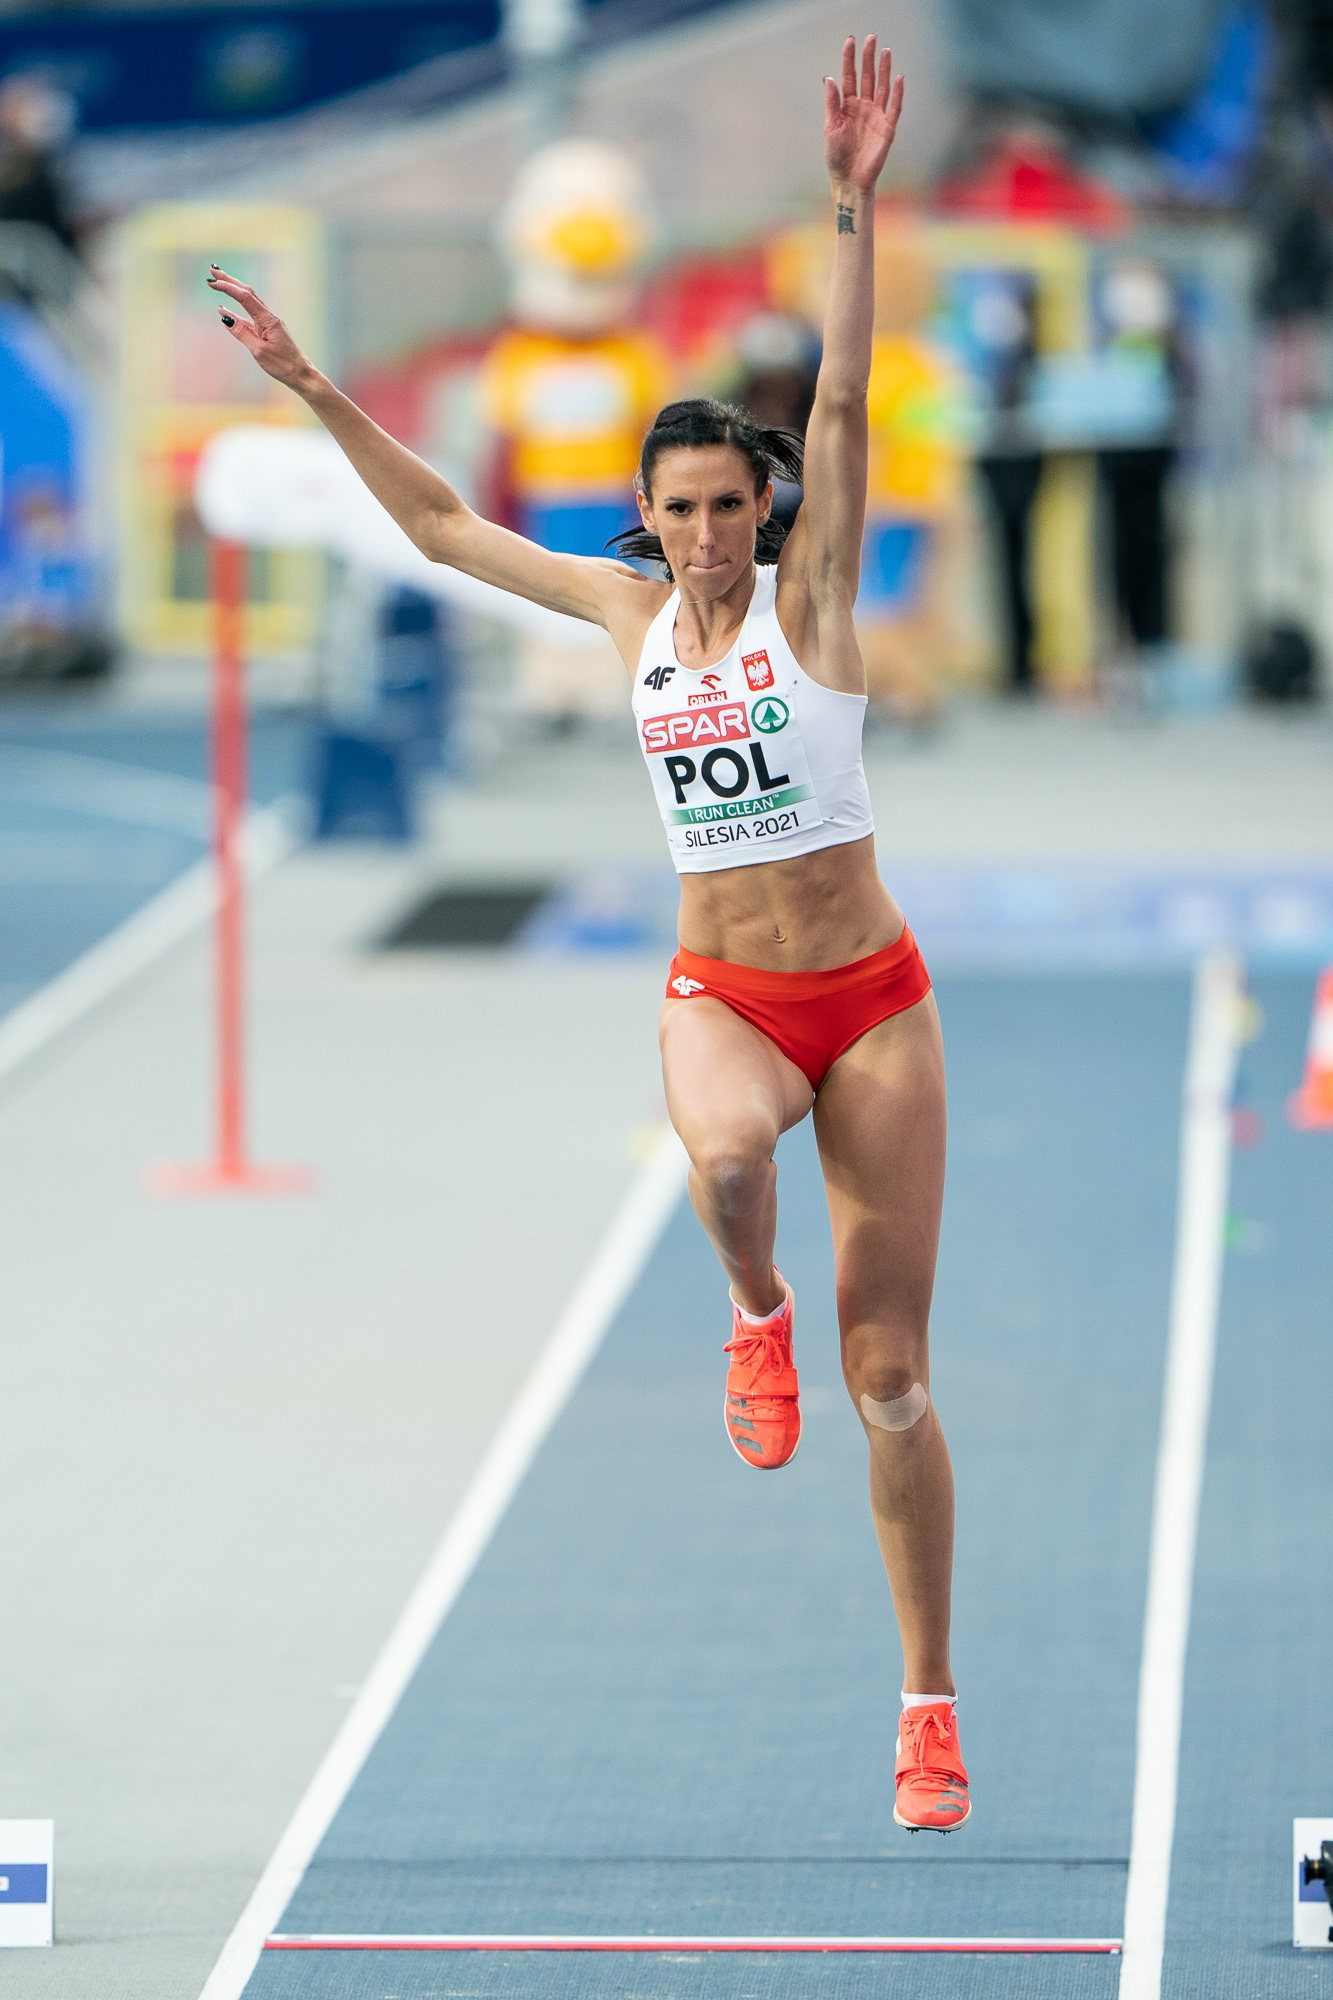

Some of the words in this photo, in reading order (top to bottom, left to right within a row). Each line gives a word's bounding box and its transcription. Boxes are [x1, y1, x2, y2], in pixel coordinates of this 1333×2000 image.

[743, 651, 766, 662] POLSKA
[690, 693, 725, 706] ORLEN
[644, 708, 747, 748] SPAR
[664, 741, 790, 804] POL
[688, 810, 694, 822] I
[695, 806, 724, 822] RUN
[685, 824, 751, 848] SILESIA
[753, 811, 800, 837] 2021
